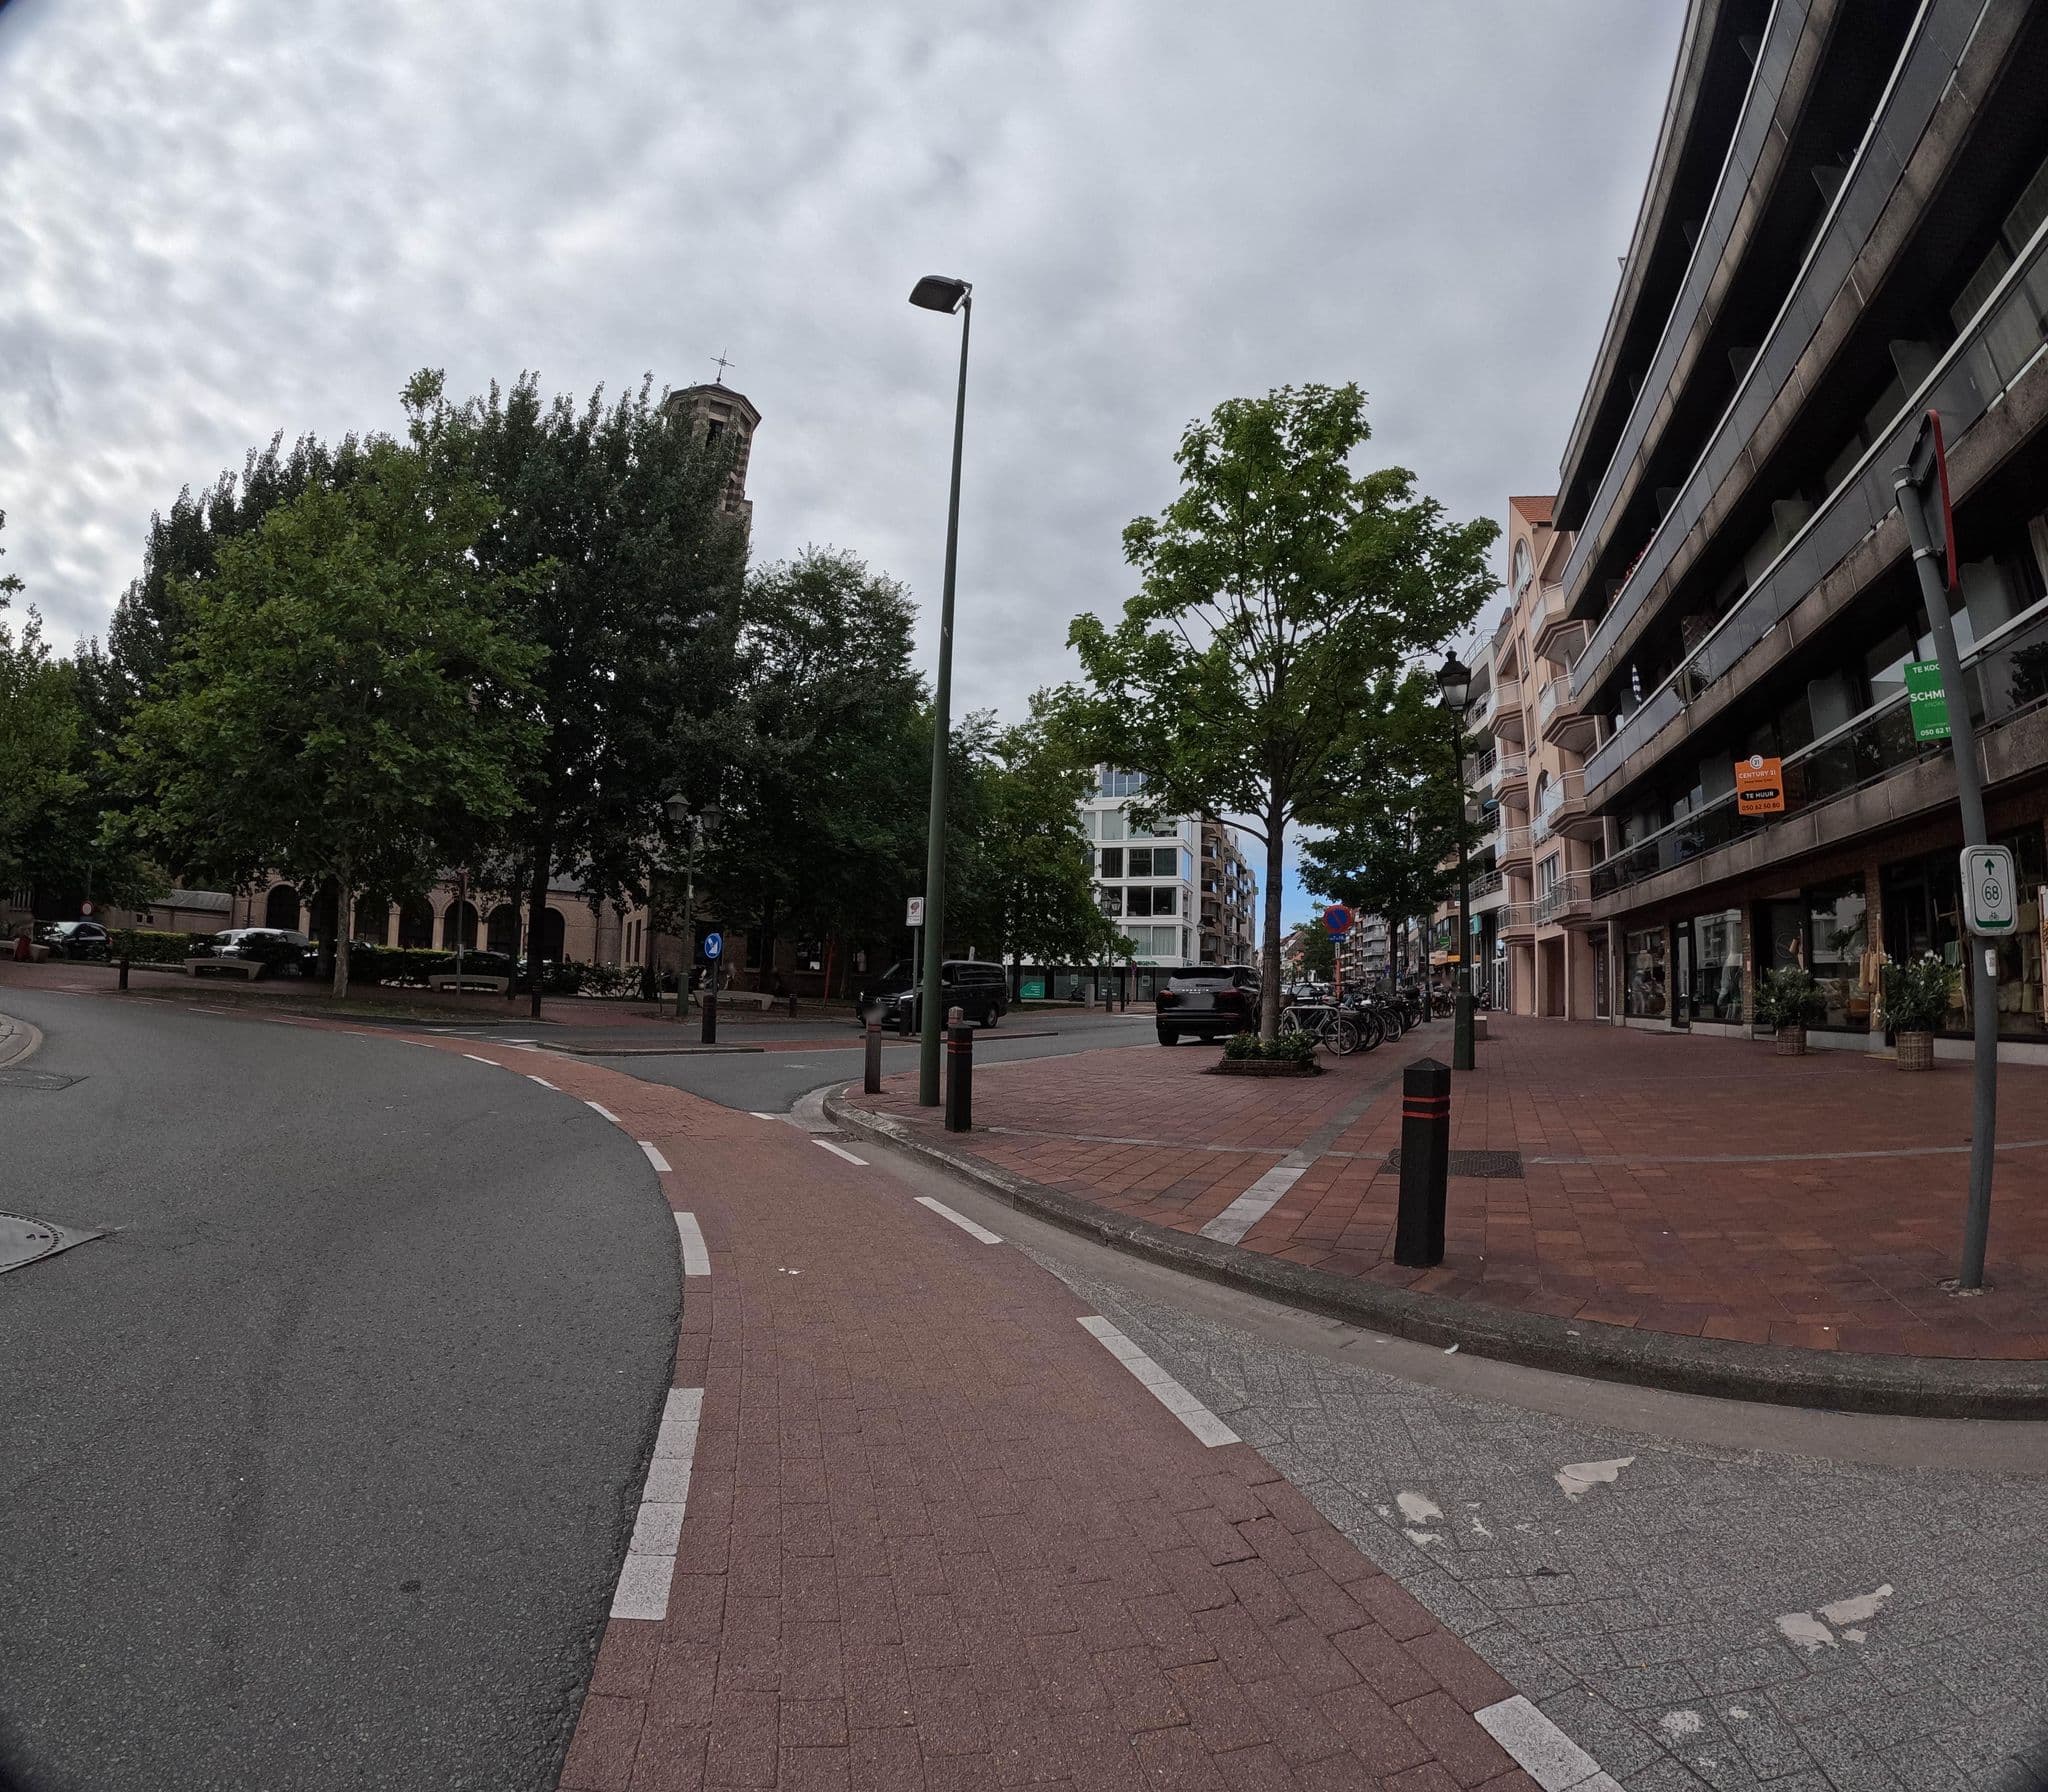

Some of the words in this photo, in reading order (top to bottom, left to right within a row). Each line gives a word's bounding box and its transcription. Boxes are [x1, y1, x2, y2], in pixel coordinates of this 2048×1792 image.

[1912, 666, 1923, 674] TE
[1924, 663, 1941, 672] KOO
[1910, 689, 1945, 702] SCHMI
[1920, 728, 1934, 736] 050
[1739, 771, 1769, 779] CENTURY
[1984, 886, 2000, 900] 68
